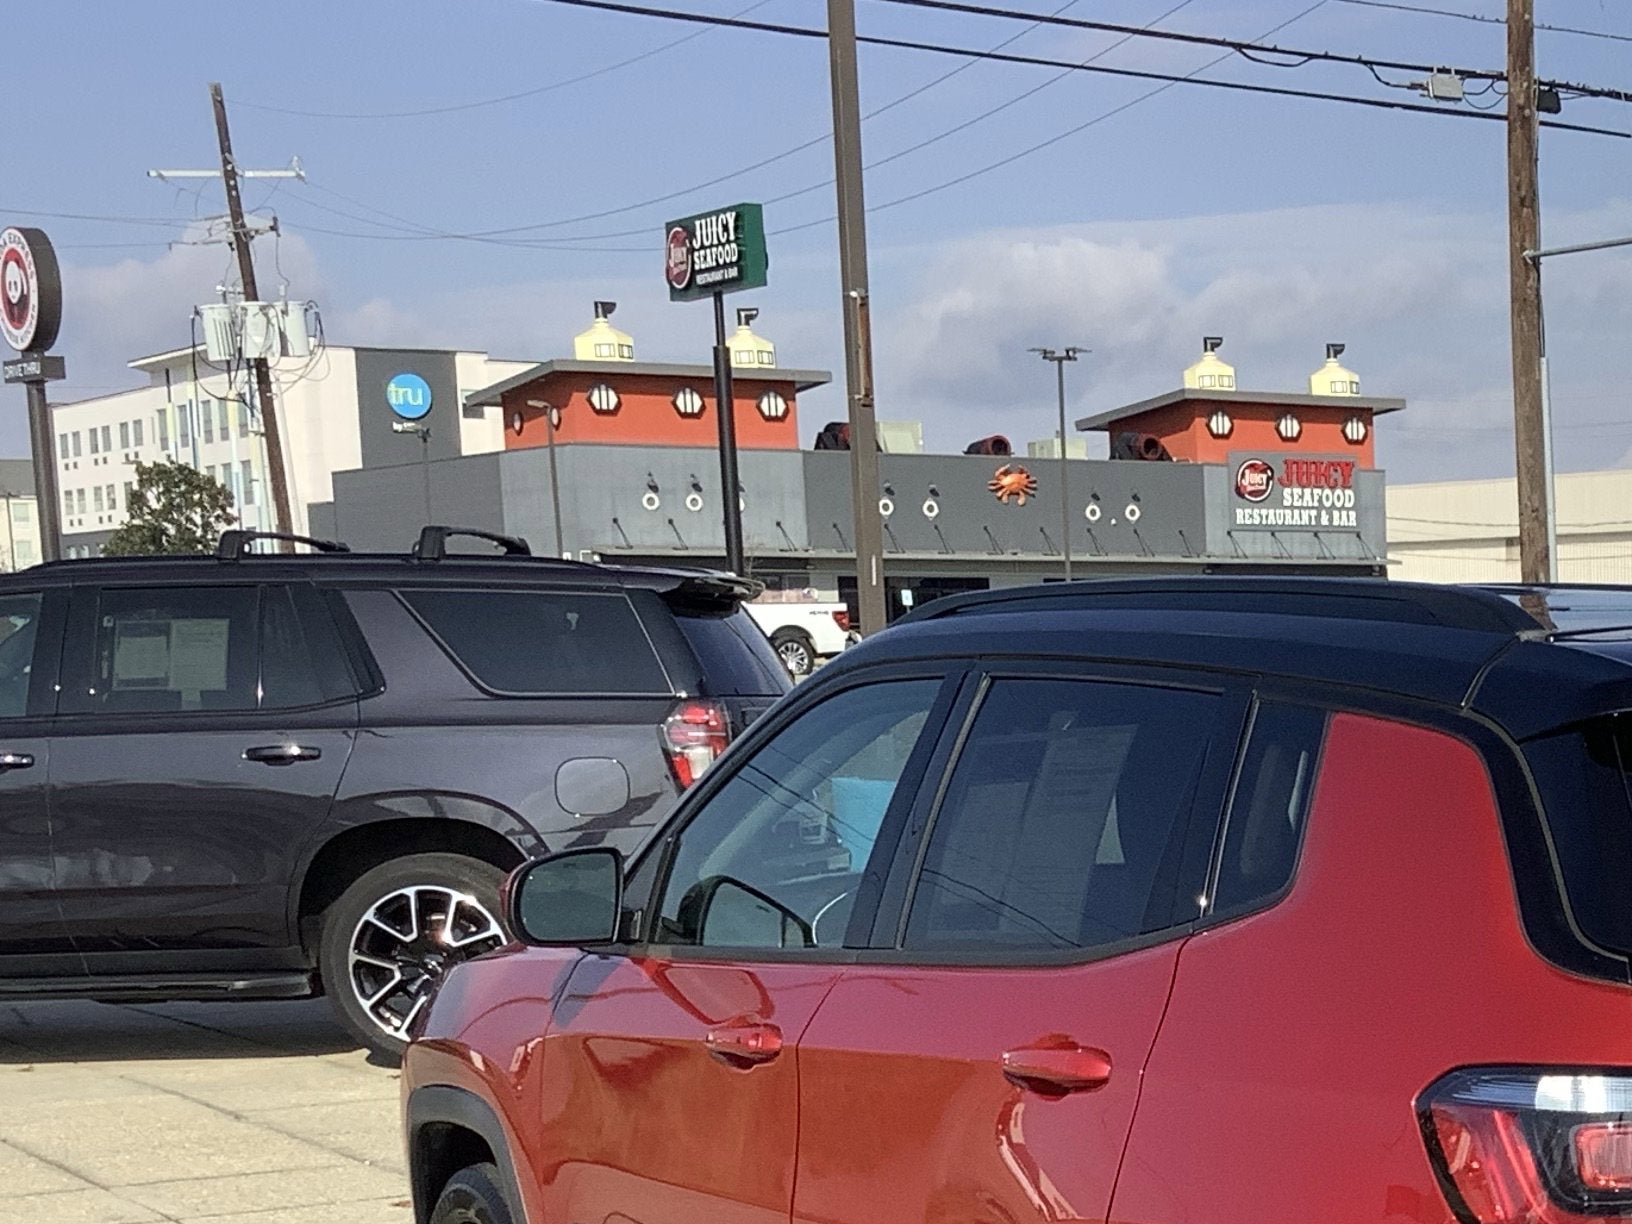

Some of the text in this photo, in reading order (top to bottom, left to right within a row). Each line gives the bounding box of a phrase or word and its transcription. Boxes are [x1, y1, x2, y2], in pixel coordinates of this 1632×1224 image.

[692, 211, 737, 250] JUICY
[693, 243, 738, 271] SEAFOOD
[388, 382, 424, 406] tru
[1278, 458, 1355, 488] JUICY
[1282, 487, 1355, 508] SEAFOOD
[1235, 508, 1357, 527] RESTAURANT & BAR
